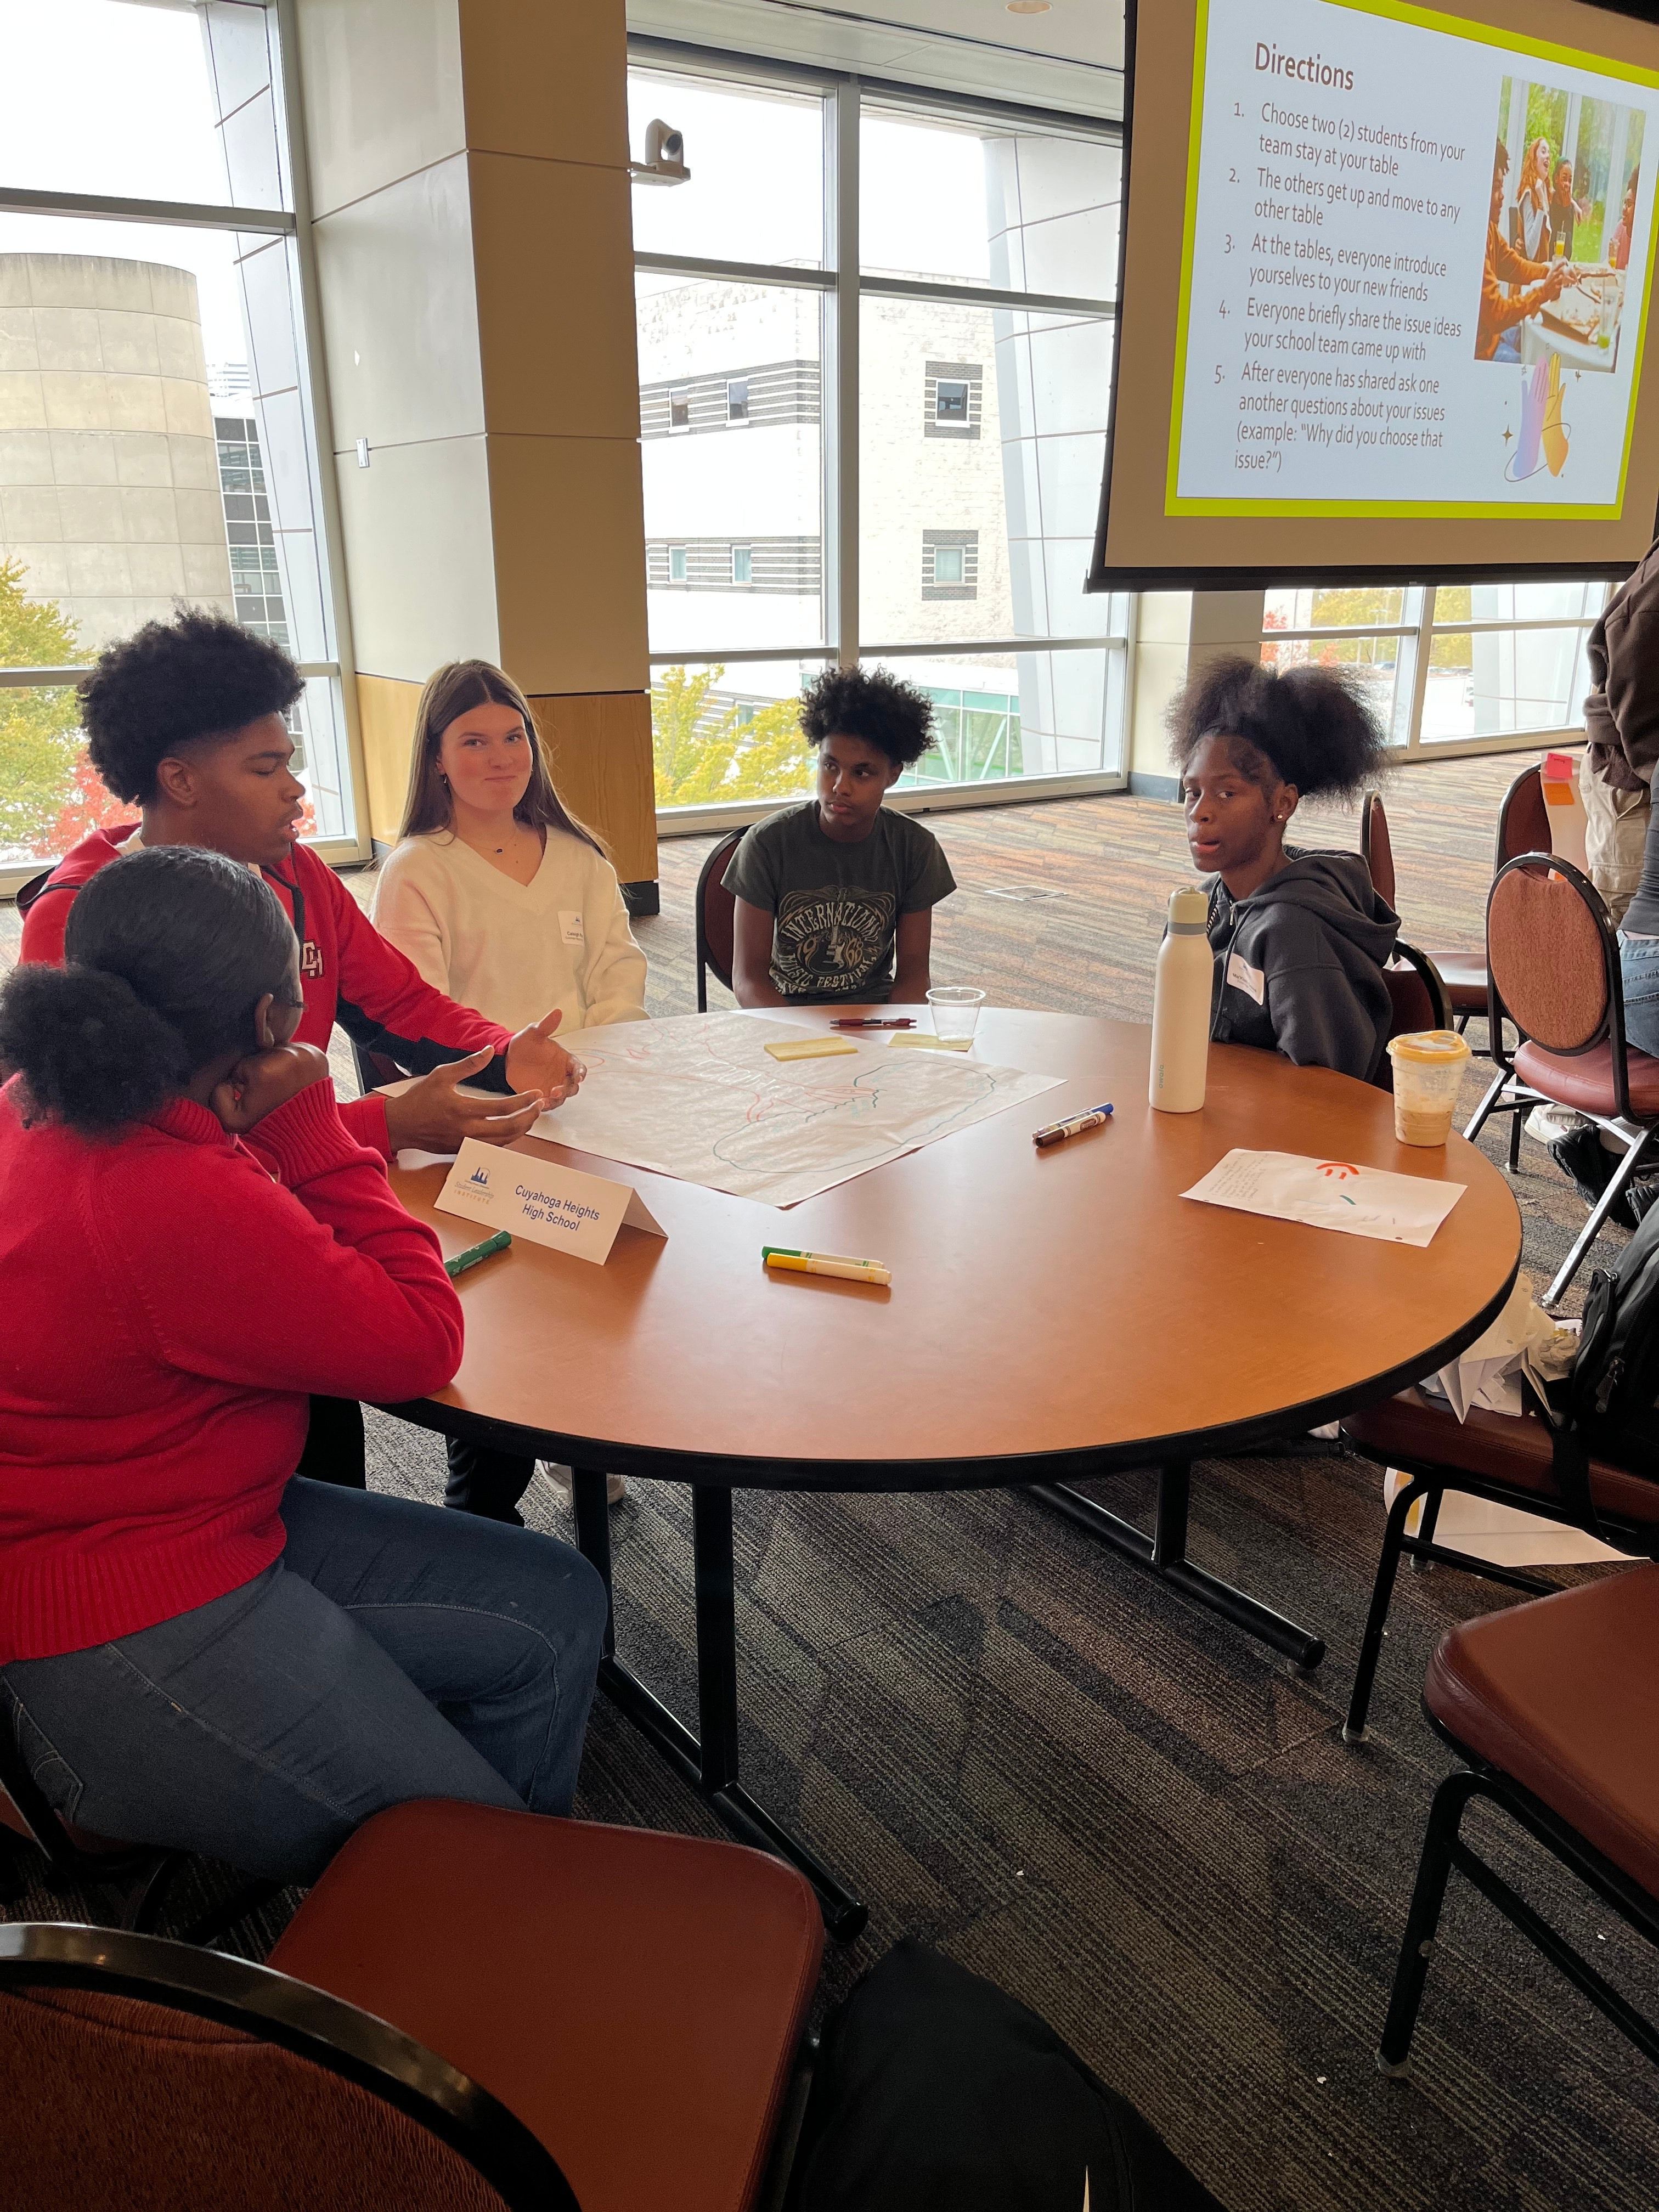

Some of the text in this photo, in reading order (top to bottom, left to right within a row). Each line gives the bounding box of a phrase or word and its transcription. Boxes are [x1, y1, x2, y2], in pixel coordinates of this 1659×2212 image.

[1255, 42, 1354, 91] Directions
[1234, 103, 1465, 162] 1. Choose two (2) students from your
[1260, 134, 1399, 176] team stay at your table
[1229, 167, 1460, 224] 2. The others get up and move to any
[1255, 198, 1323, 225] other table
[1224, 233, 1447, 277] 3. At the tables, everyone introduce
[1250, 266, 1428, 302] yourselves to your new friends
[1219, 297, 1462, 337] 4. Everyone briefly share the issue ideas
[1244, 329, 1426, 363] your school team came up with
[1214, 360, 1439, 394] 5. After everyone has shared ask one
[1239, 392, 1445, 424] another questions about your issues
[1237, 420, 1443, 449] (example: "Why did you choose that
[777, 953, 814, 986] MUSIC
[515, 1184, 561, 1209] Cuyahoga
[563, 1200, 600, 1221] Heights
[522, 1204, 581, 1232] High School
